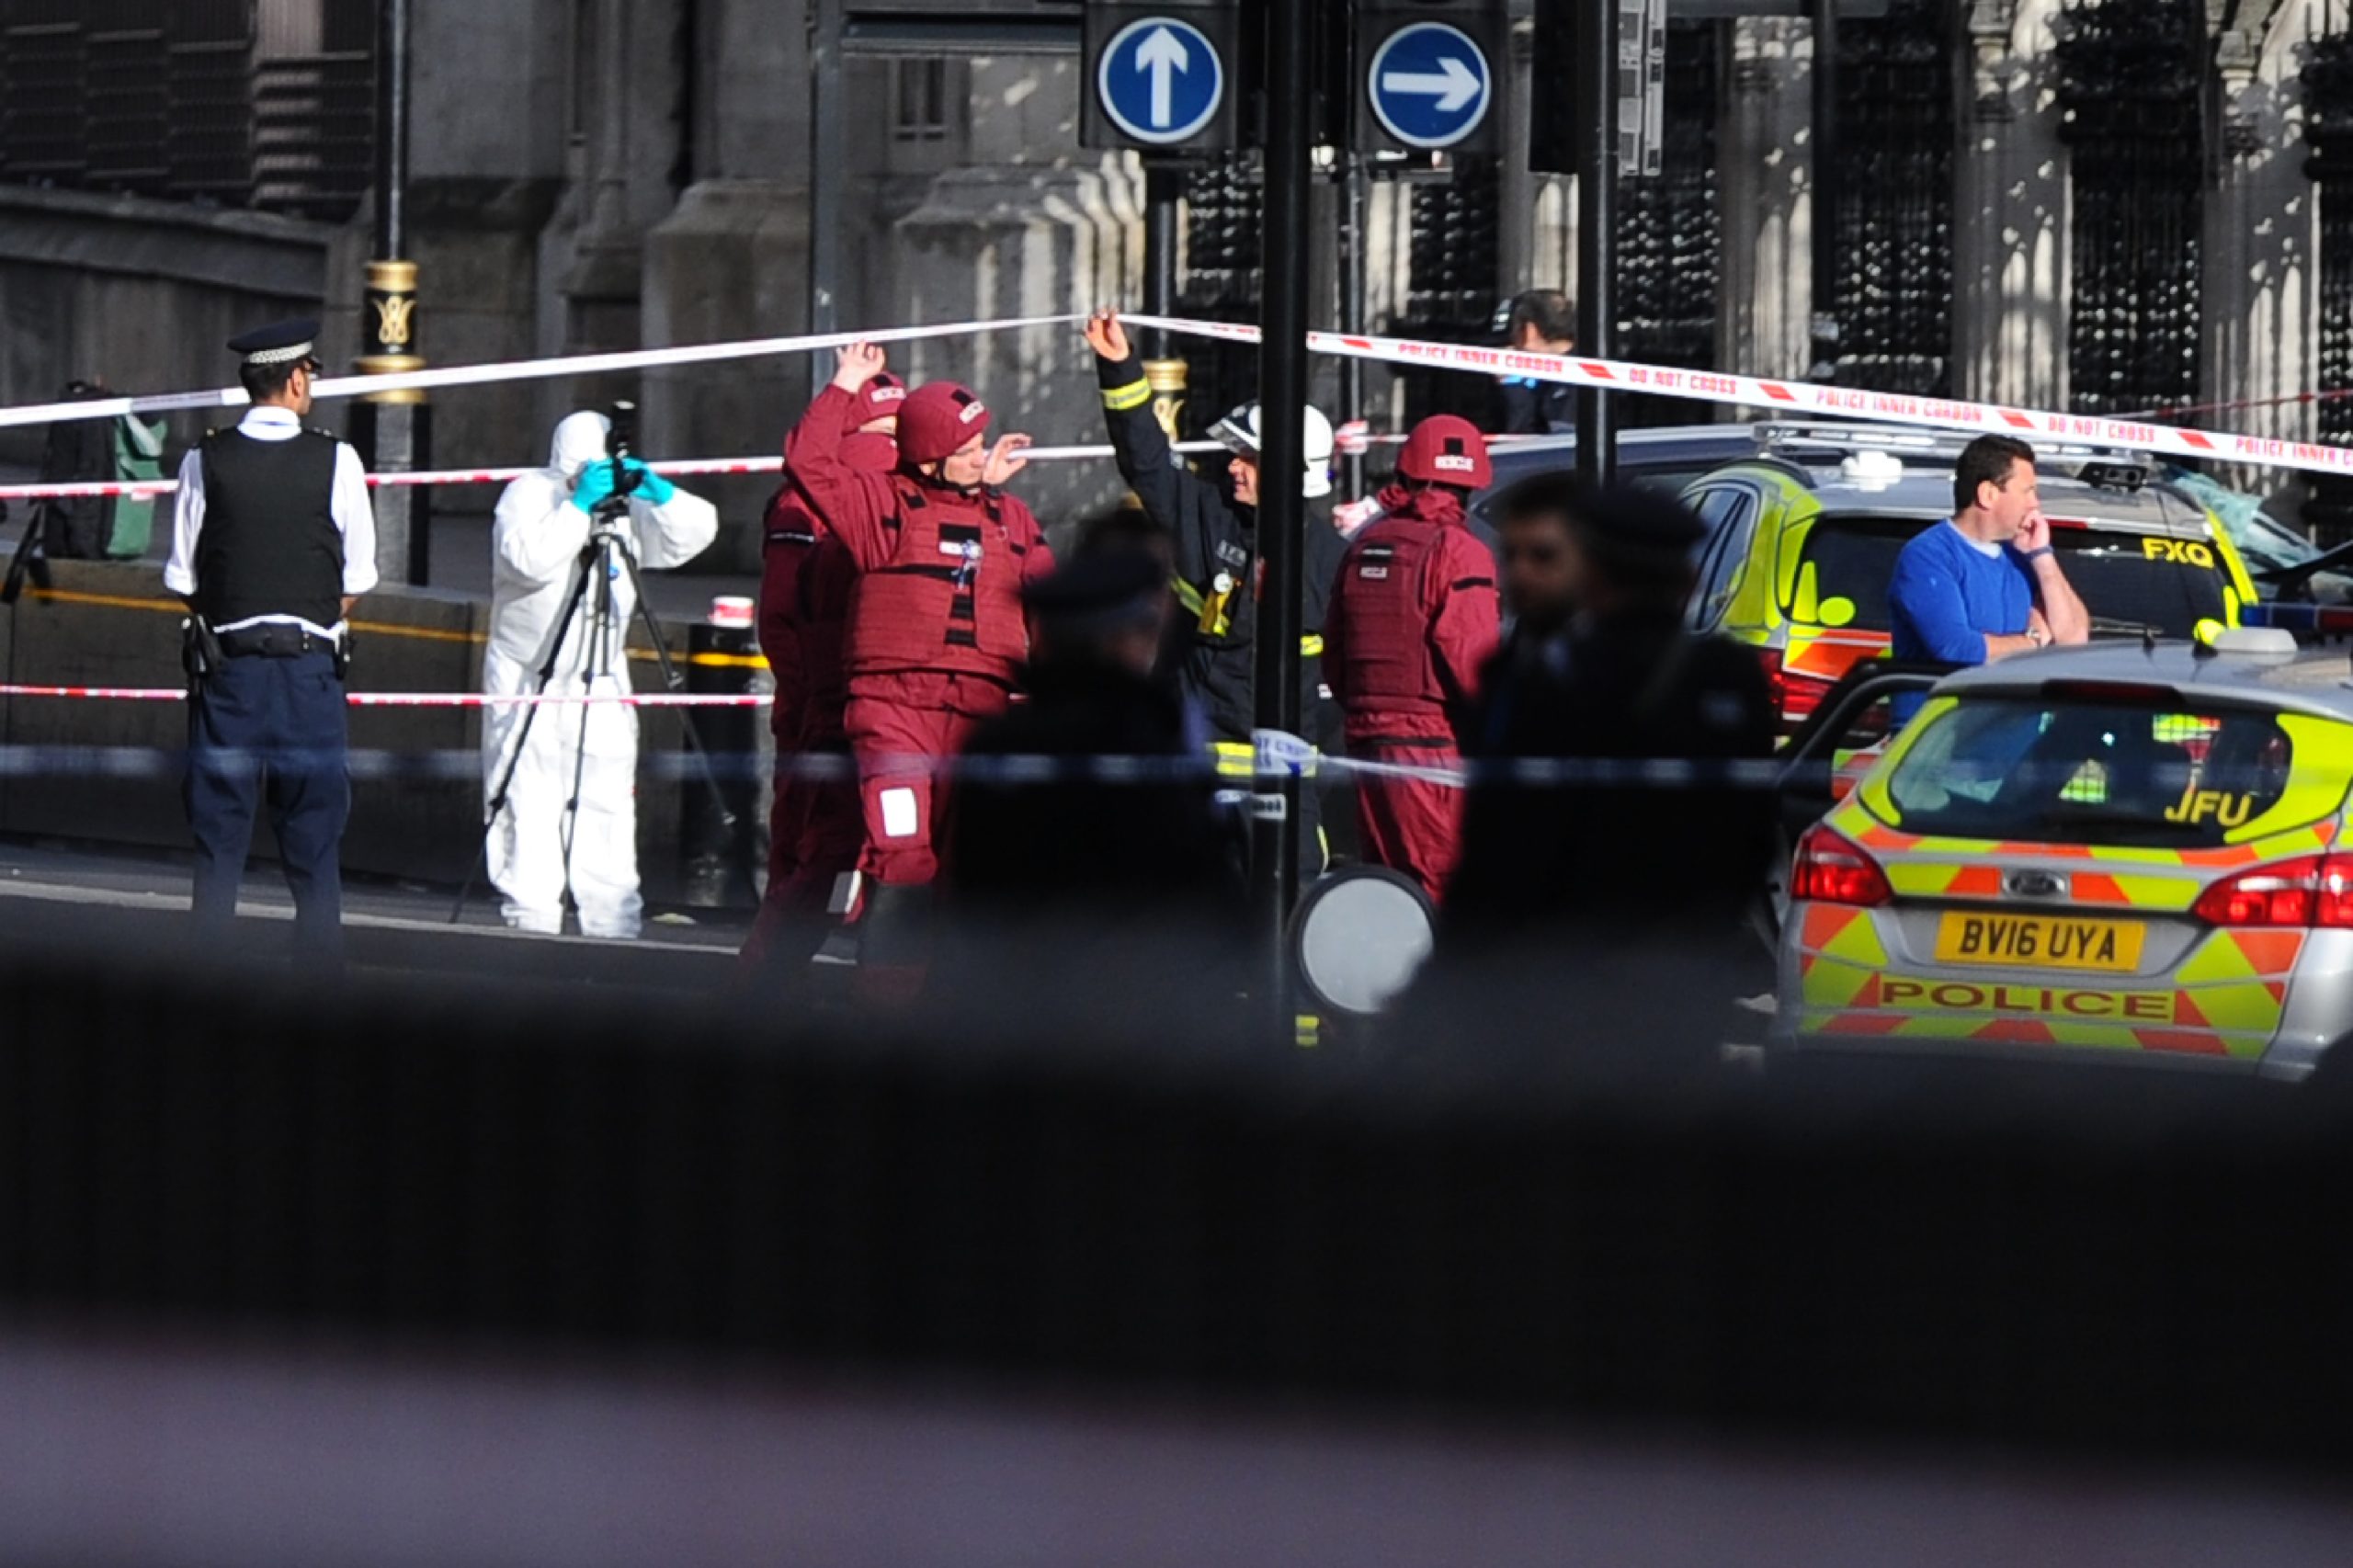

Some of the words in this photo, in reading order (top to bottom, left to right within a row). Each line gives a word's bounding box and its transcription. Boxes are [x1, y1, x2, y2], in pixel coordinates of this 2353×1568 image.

[2048, 415, 2066, 433] DO
[2074, 419, 2101, 437] NOT
[2109, 423, 2154, 443] CROSS
[2164, 790, 2252, 825] JFU
[1958, 919, 2040, 958] BV16
[2048, 923, 2116, 962] UYA
[1881, 982, 2170, 1020] POLICE
